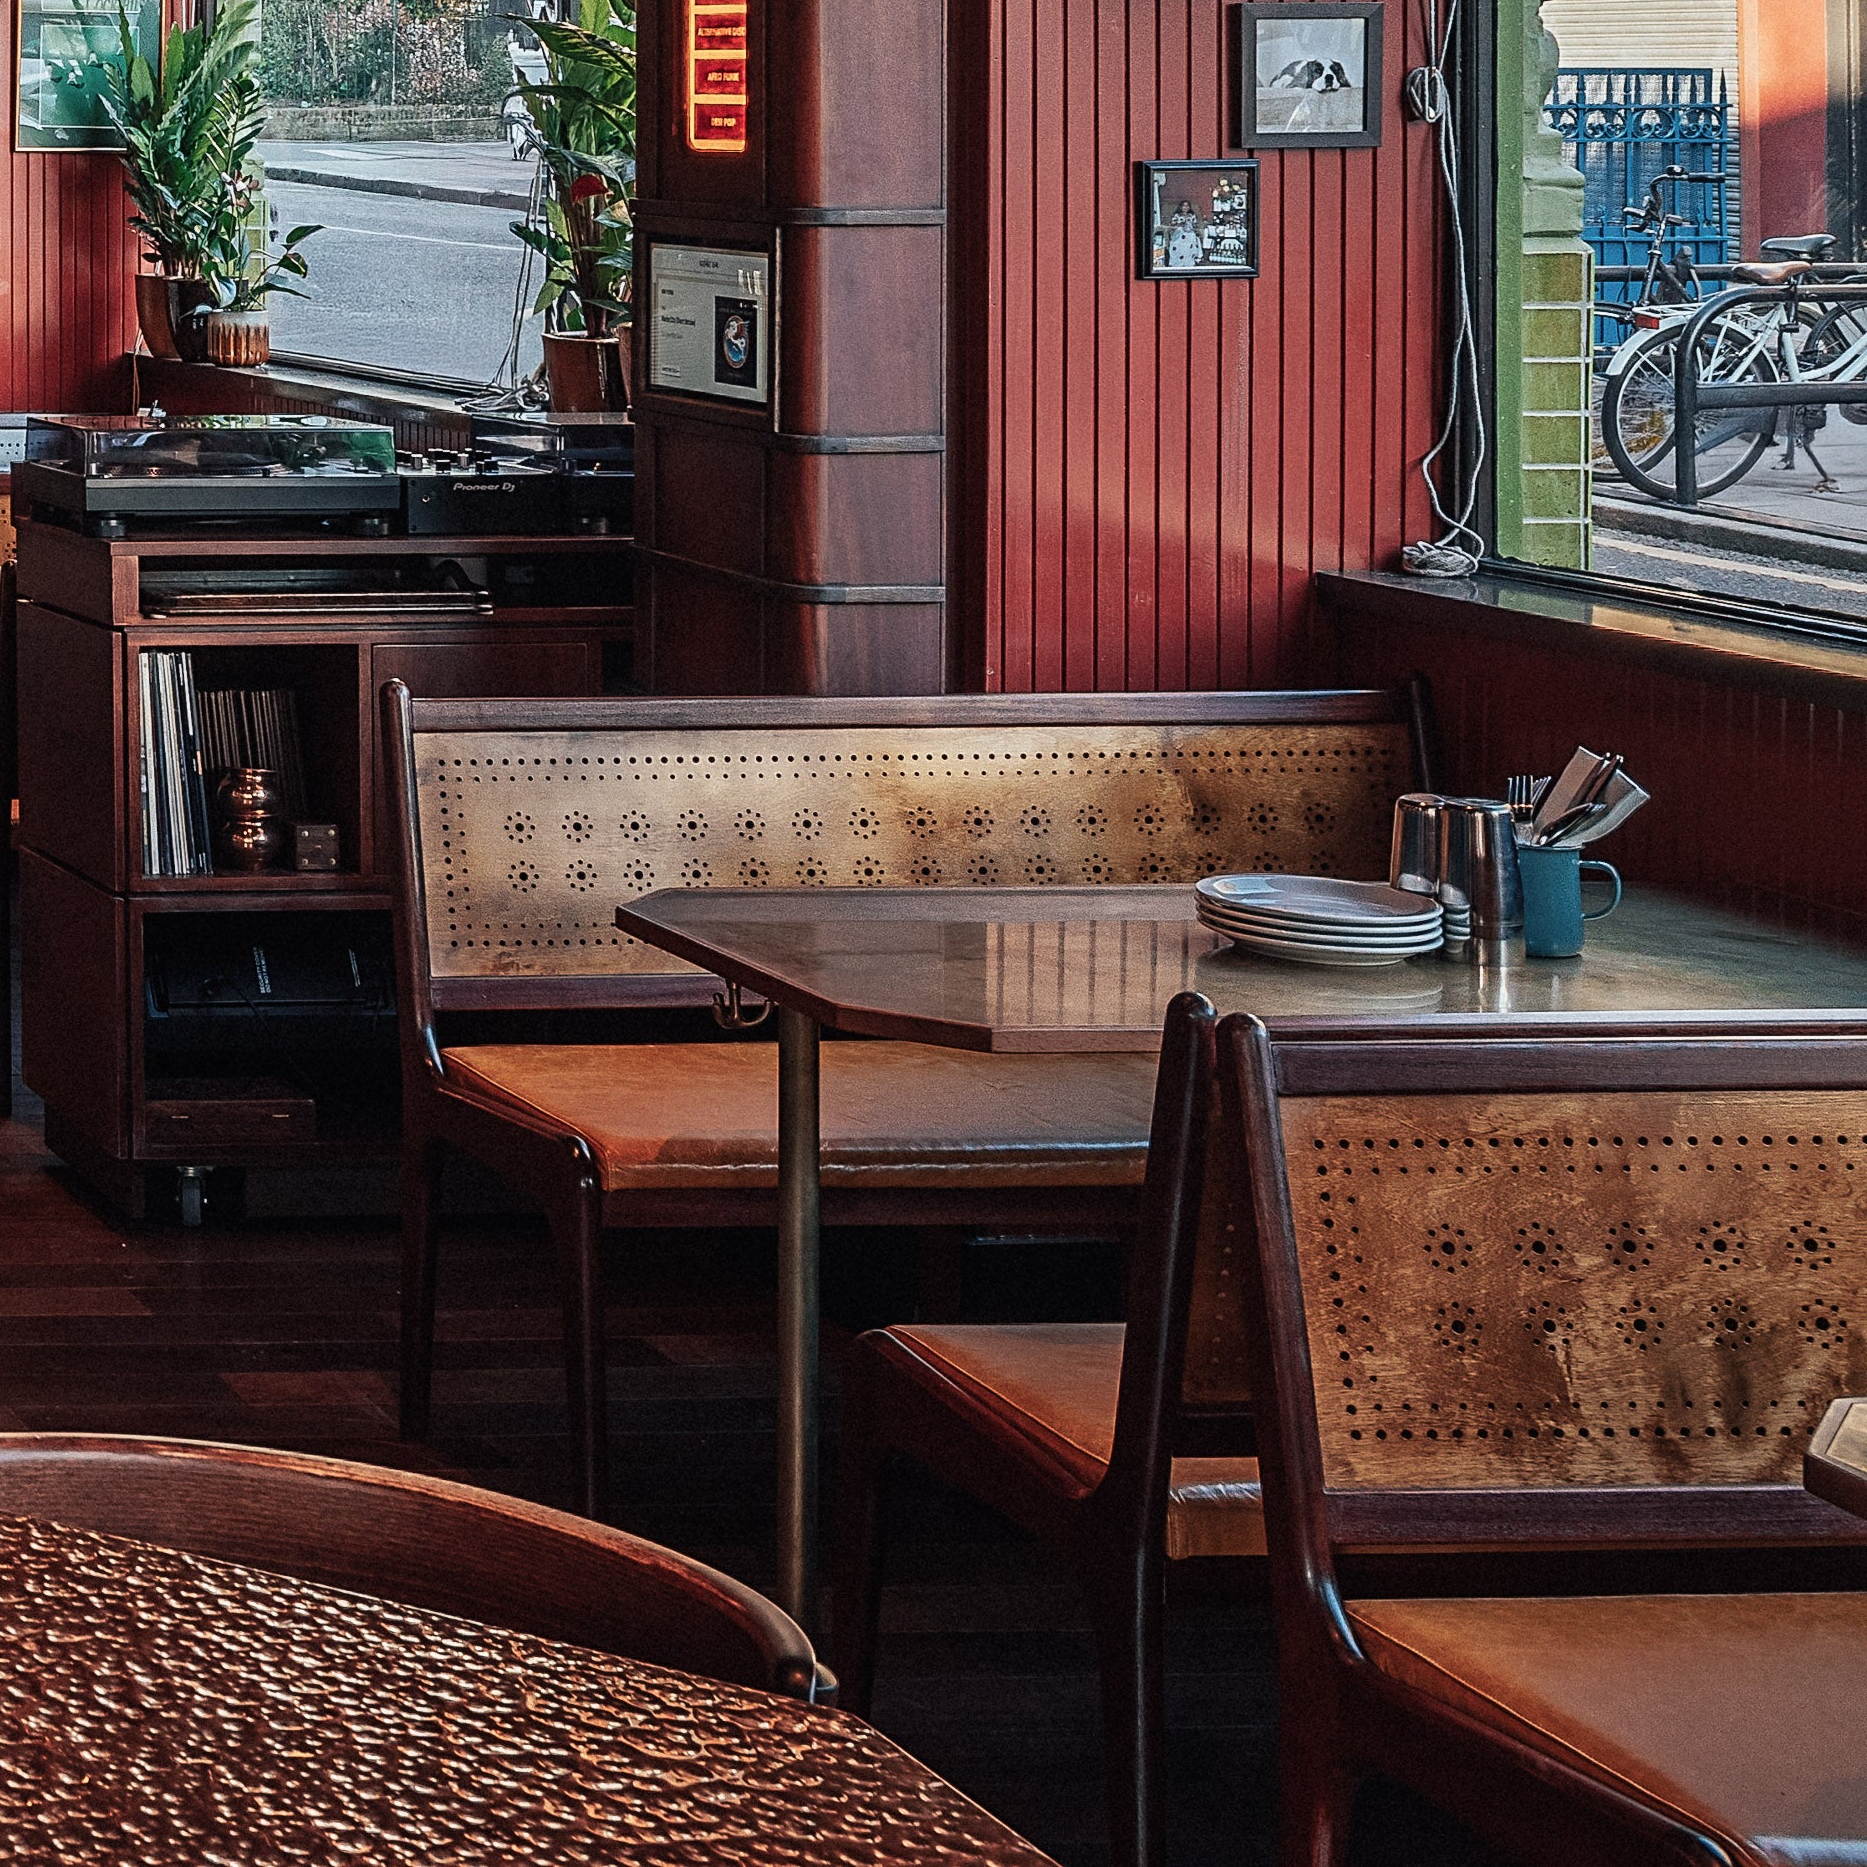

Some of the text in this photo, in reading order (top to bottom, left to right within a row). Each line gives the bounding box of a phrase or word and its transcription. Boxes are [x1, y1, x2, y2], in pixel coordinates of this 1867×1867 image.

[707, 72, 739, 82] AFRO FUNK
[723, 117, 737, 127] POP
[453, 482, 500, 491] Pioneer
